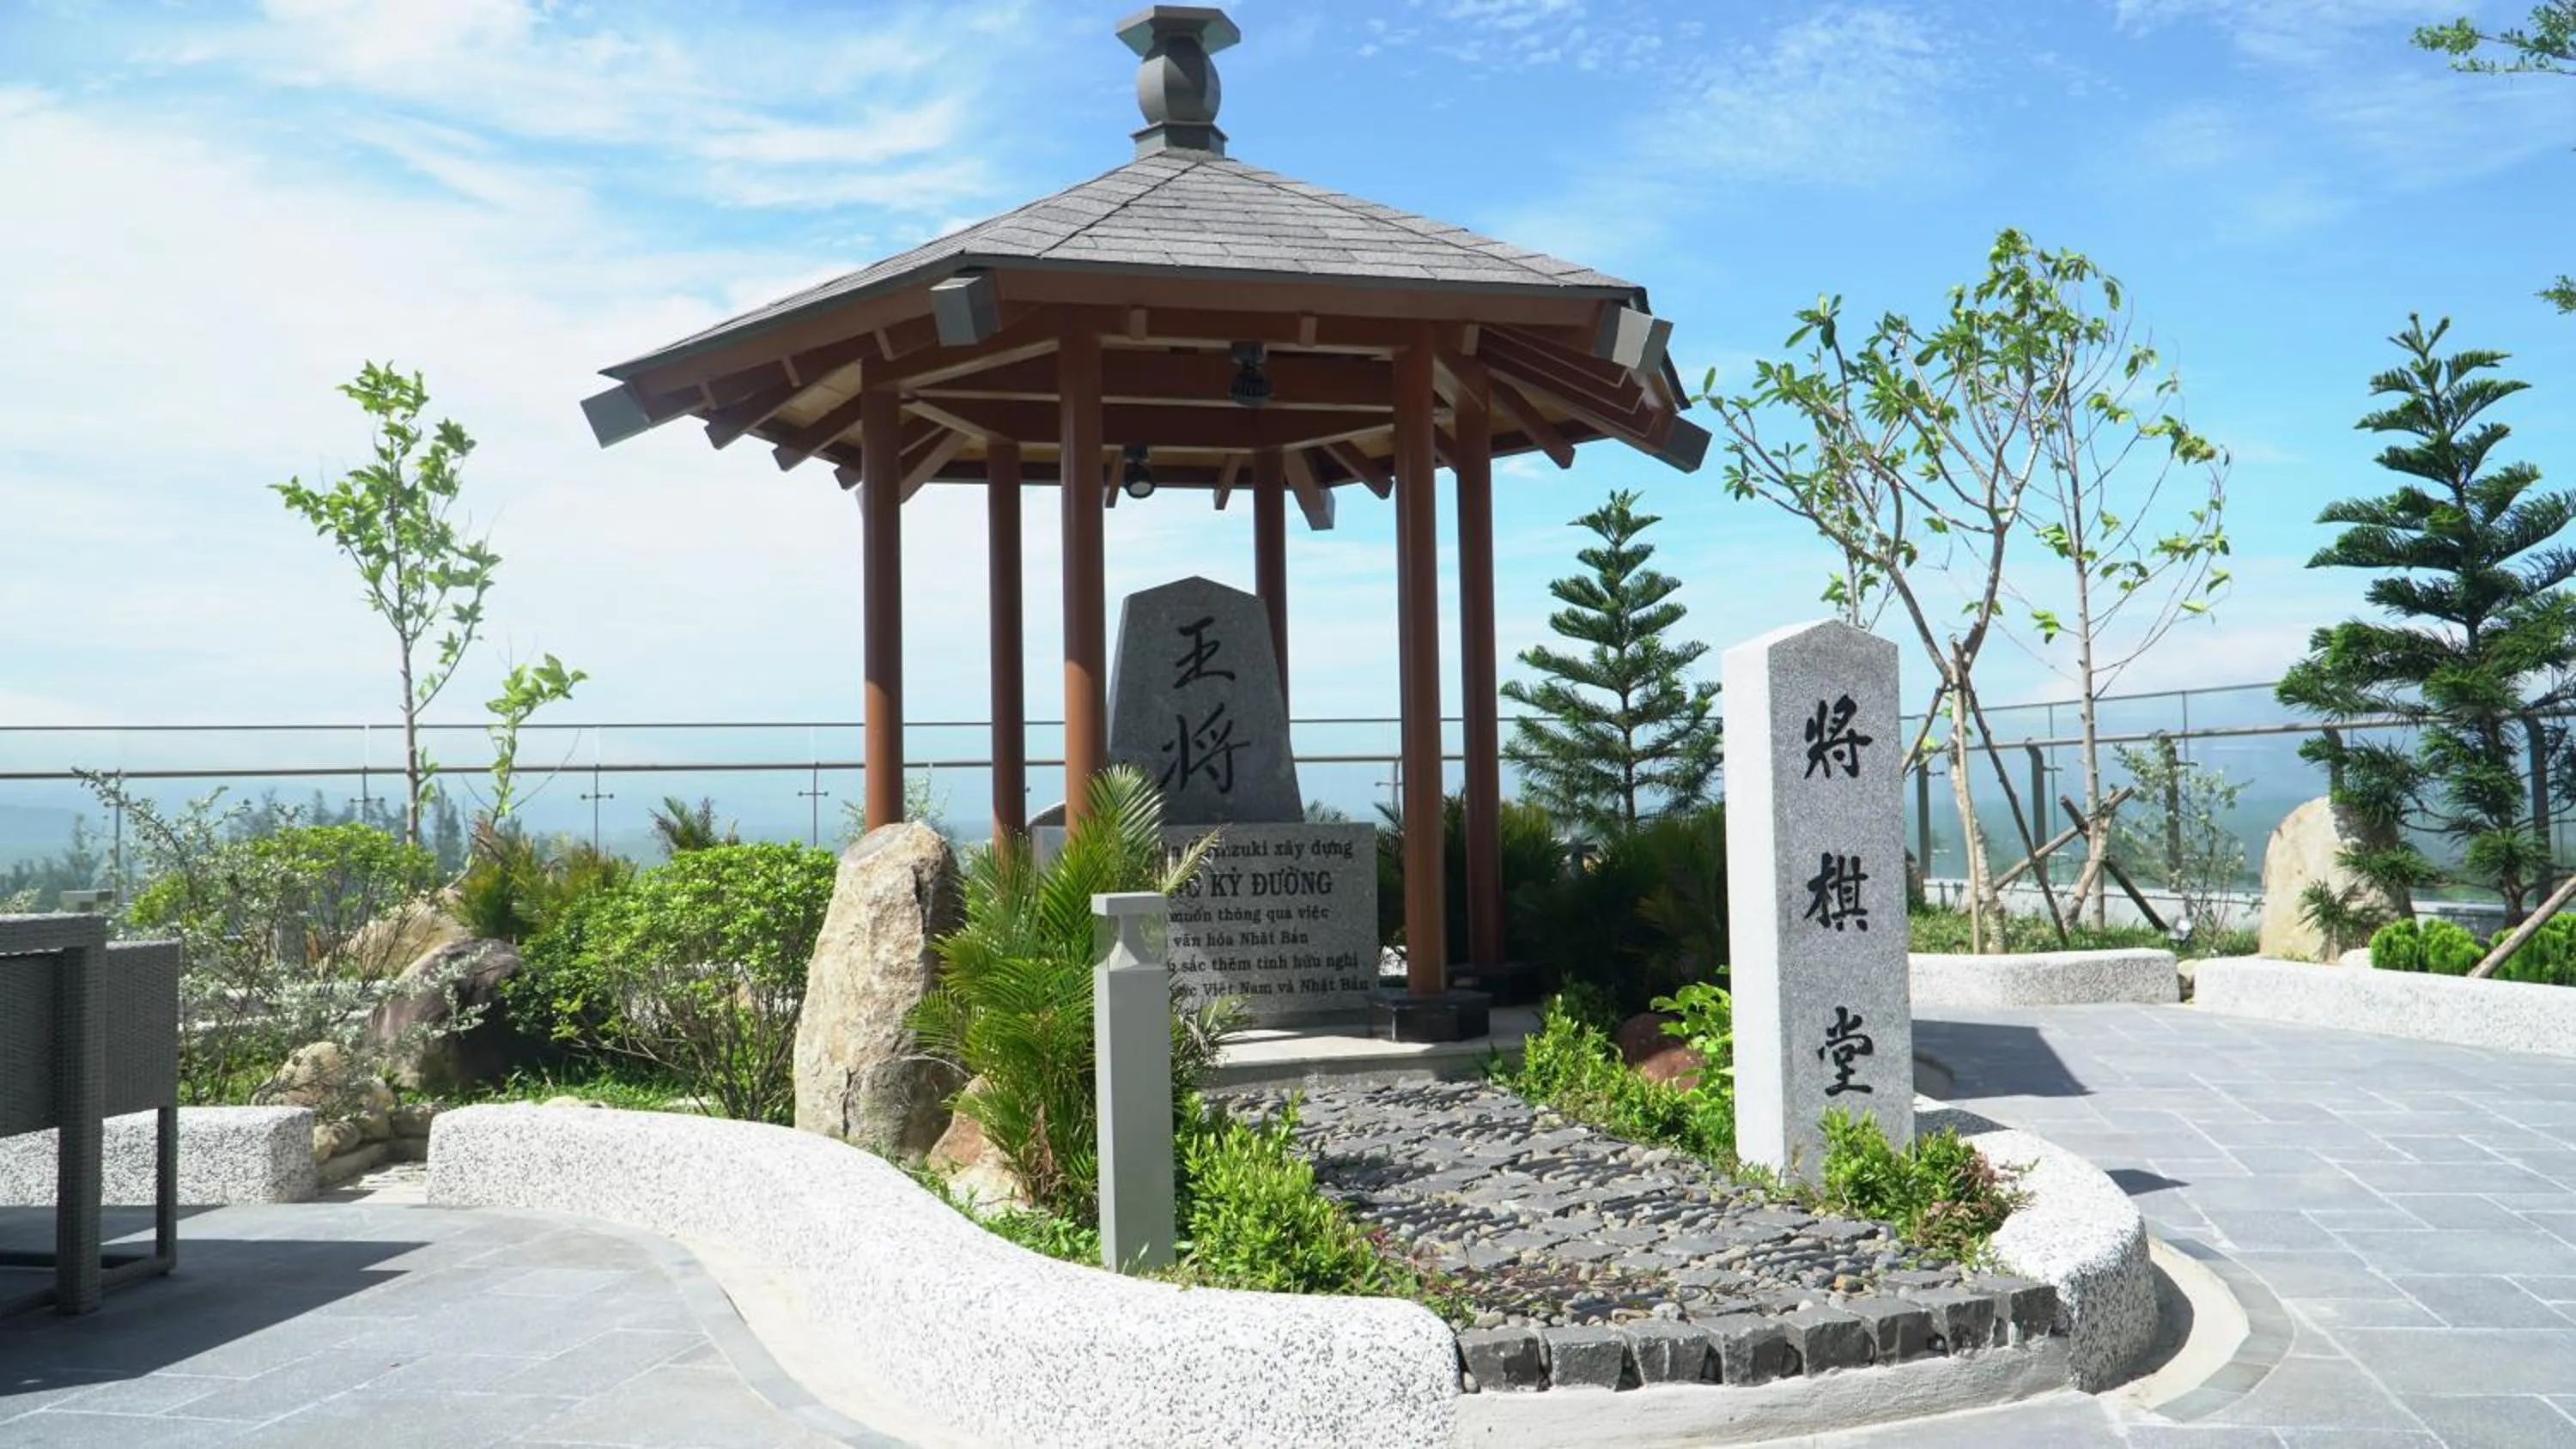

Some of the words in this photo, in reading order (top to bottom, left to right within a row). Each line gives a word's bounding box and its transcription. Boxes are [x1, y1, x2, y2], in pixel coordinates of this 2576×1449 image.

[1273, 838, 1304, 861] xây
[1310, 838, 1354, 860] dựng
[1252, 866, 1333, 896] ĐƯỜNG
[1267, 910, 1293, 922] qua
[1297, 904, 1330, 920] việc
[1173, 934, 1202, 949] văn
[1212, 957, 1252, 972] thêm
[1238, 981, 1273, 995] Nam
